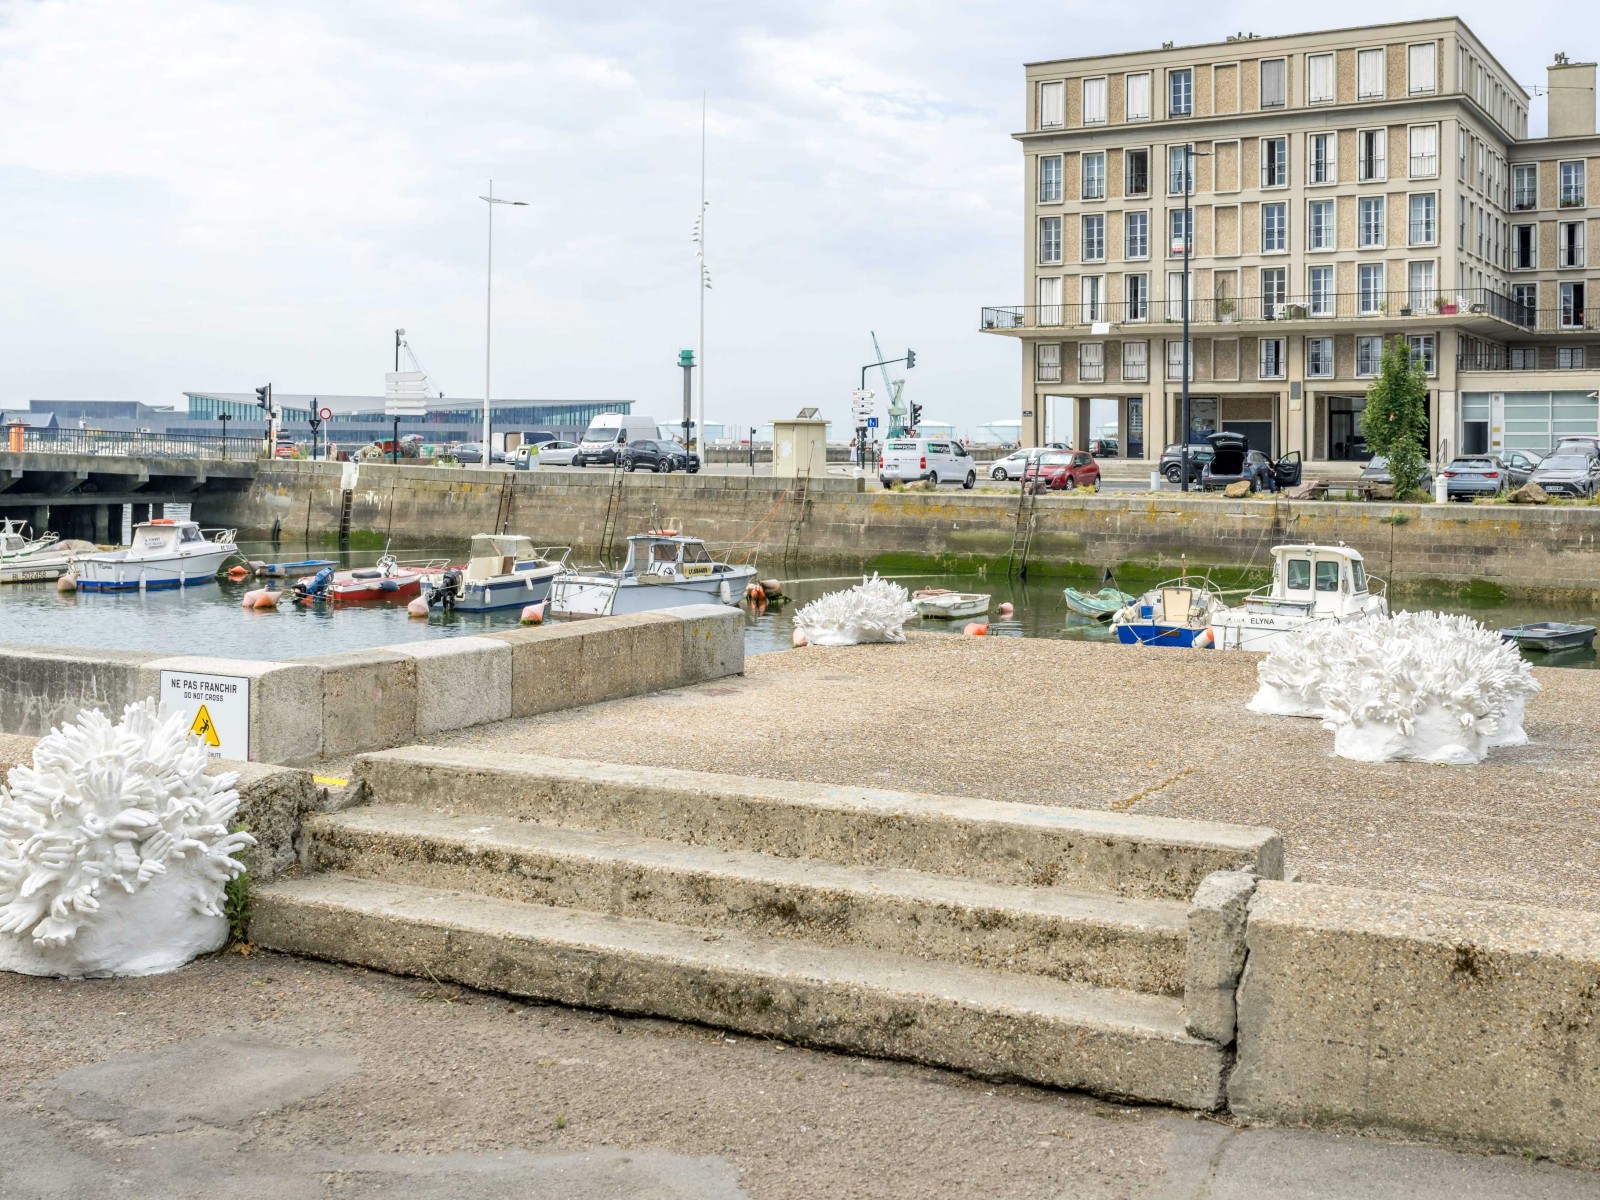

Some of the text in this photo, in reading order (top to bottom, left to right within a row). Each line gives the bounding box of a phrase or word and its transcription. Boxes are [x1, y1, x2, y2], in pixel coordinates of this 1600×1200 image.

[1250, 617, 1275, 625] ELYNA
[171, 679, 237, 693] NE PAS FRANCHIR
[193, 692, 203, 700] NOT
[205, 694, 223, 702] CROSS
